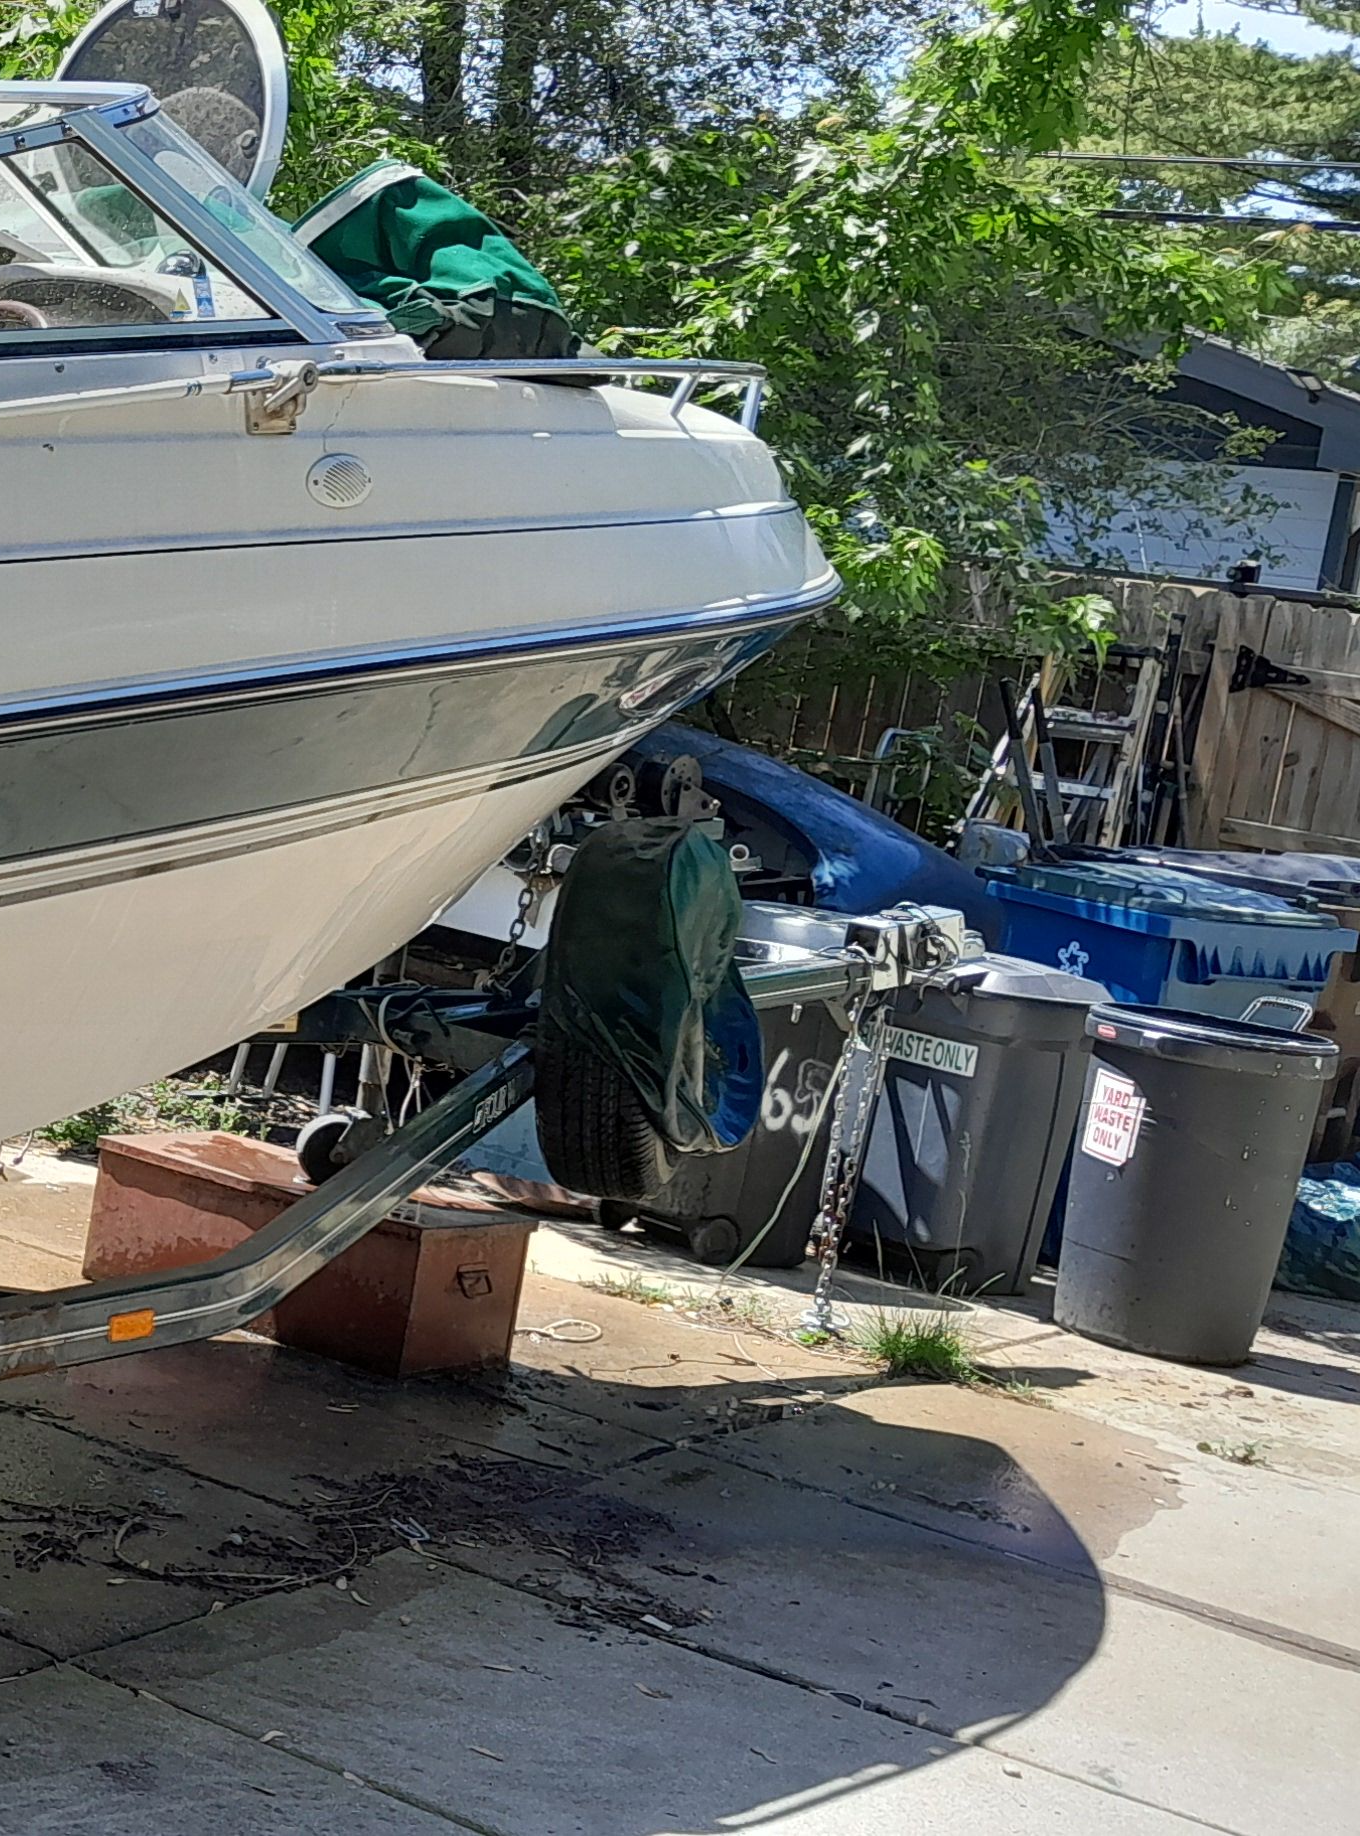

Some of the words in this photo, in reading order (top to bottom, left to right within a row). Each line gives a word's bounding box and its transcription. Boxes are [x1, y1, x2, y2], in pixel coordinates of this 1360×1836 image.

[883, 1028, 933, 1063] WASTE
[932, 1041, 975, 1073] ONLY
[1103, 1085, 1131, 1109] YARD
[1094, 1105, 1134, 1132] WASTE
[1092, 1126, 1121, 1151] ONLY
